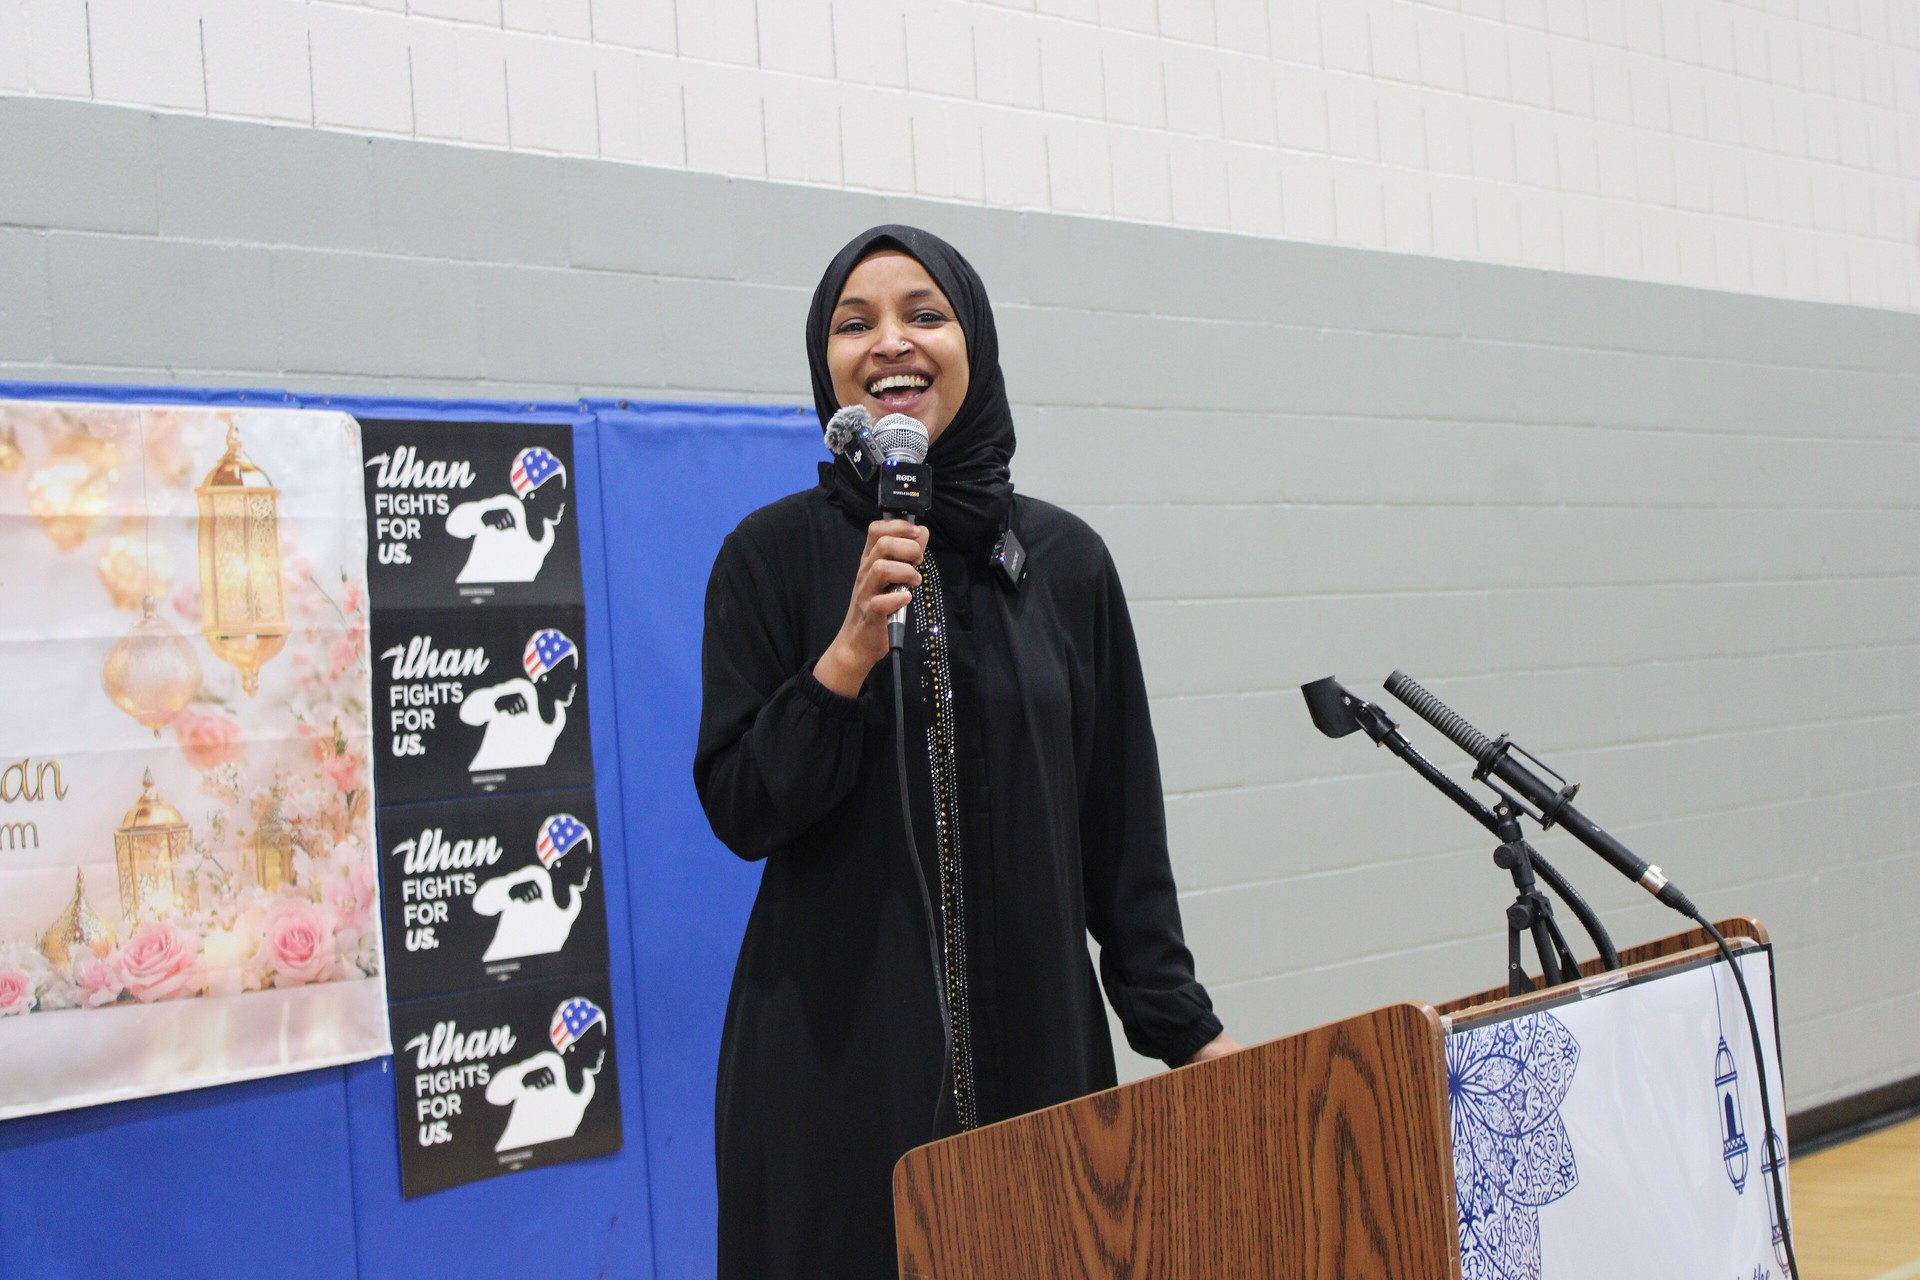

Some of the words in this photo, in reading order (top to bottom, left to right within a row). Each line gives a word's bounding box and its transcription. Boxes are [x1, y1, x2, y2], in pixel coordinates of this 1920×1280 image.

[374, 493, 450, 516] FIGHTS
[376, 517, 422, 540] FOR
[378, 541, 412, 564] US.
[389, 682, 464, 707] FIGHTS
[391, 708, 435, 732] FOR
[392, 734, 426, 757] US.
[0, 757, 69, 803] an
[402, 873, 477, 903] FIGHTS
[404, 901, 449, 927] FOR
[406, 927, 440, 952] US.
[415, 1065, 490, 1097] FIGHTS
[417, 1095, 462, 1122] FOR
[418, 1121, 453, 1147] US.
